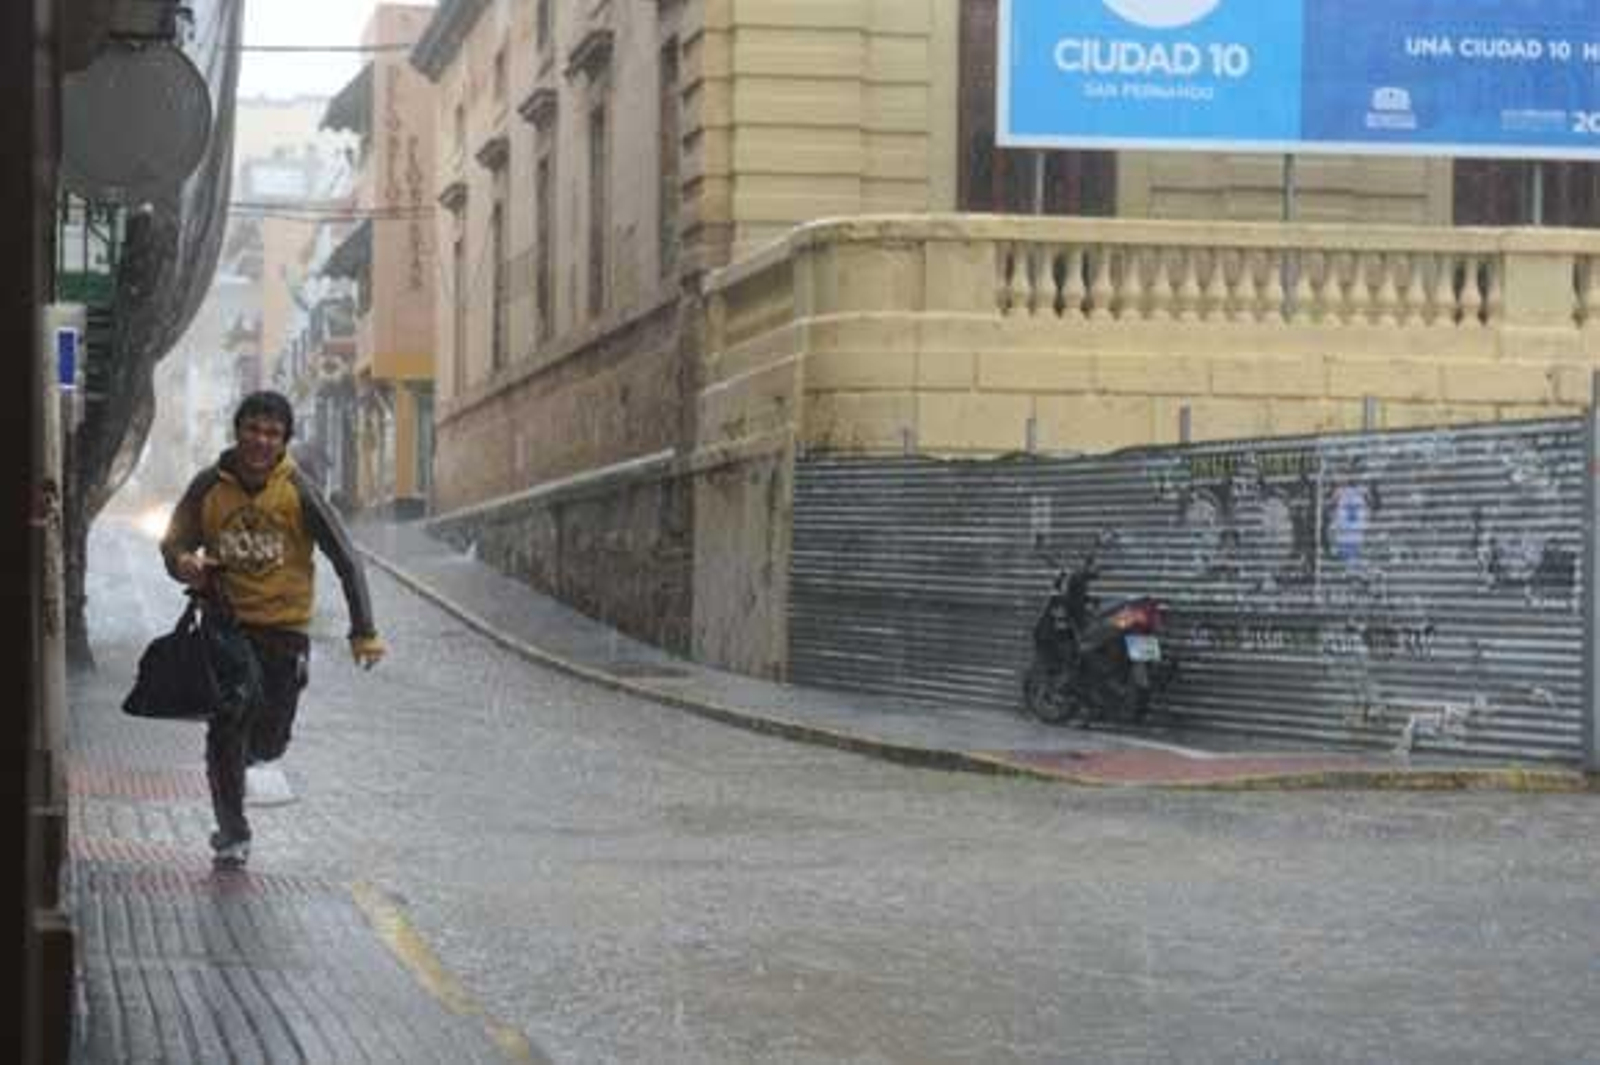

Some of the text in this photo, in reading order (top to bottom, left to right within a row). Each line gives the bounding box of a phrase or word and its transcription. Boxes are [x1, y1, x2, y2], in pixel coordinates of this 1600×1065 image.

[1055, 38, 1250, 78] CIUDAD 10
[1405, 37, 1453, 56] UNA
[1459, 39, 1542, 59] CIUDAD
[1549, 41, 1571, 60] 10
